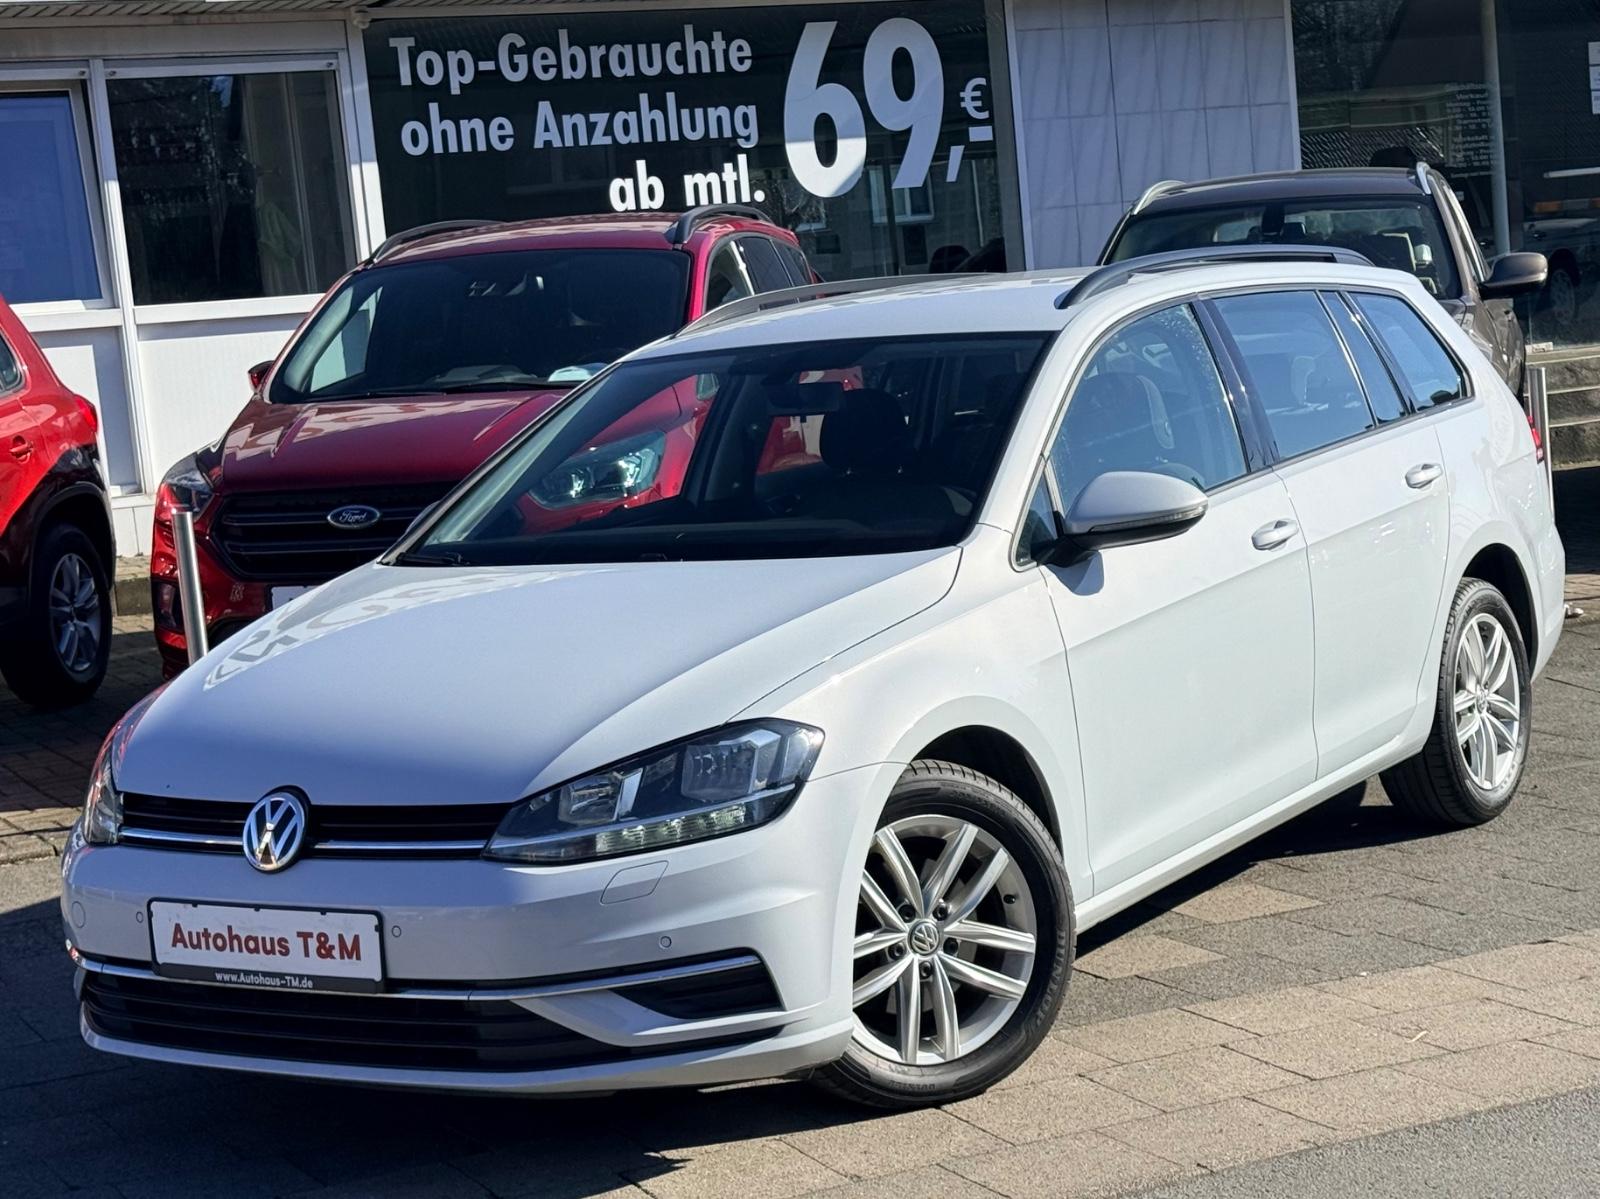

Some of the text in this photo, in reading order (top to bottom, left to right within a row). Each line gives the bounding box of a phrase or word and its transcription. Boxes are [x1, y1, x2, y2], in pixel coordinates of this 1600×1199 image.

[388, 25, 753, 95] Top-Gebrauchte
[400, 92, 759, 156] ohne Anzahlung
[609, 154, 766, 213] ab mtl.
[339, 510, 368, 522] Ford
[171, 922, 362, 962] Autohaus T&M
[214, 970, 314, 990] www.Autohaus-TM.de
